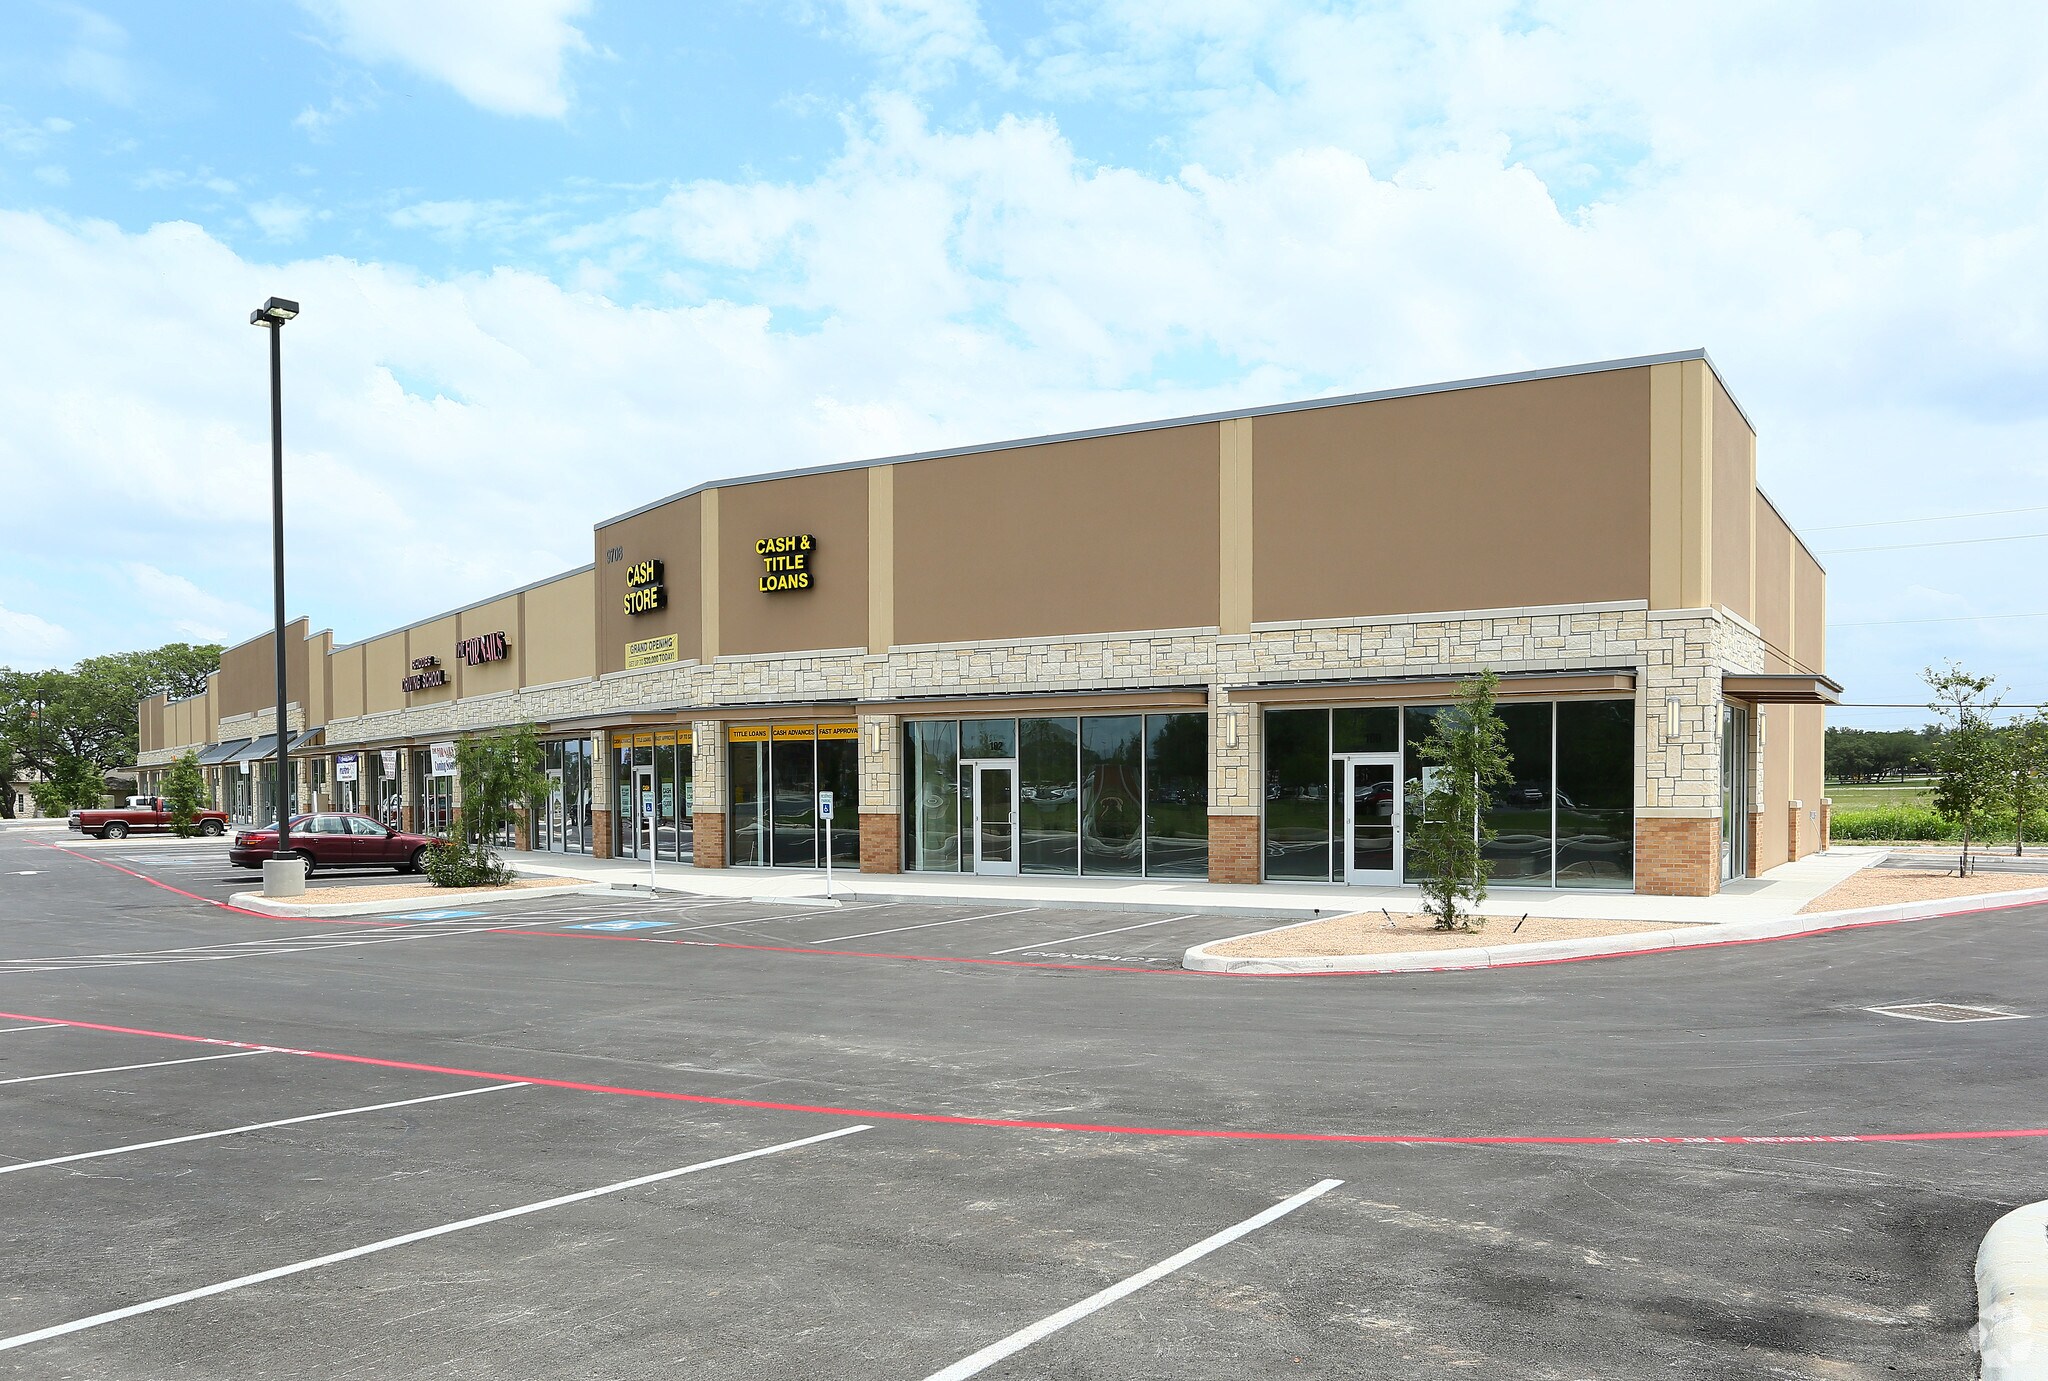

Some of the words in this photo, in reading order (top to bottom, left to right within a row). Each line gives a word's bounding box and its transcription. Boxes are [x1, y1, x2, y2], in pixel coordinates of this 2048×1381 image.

[755, 537, 796, 555] CASH
[799, 535, 811, 550] &
[626, 560, 654, 587] CASH
[763, 555, 804, 572] TITLE
[759, 572, 809, 592] LOANS
[624, 587, 658, 615] STORE
[465, 637, 480, 666] FOR
[480, 631, 505, 662] NAILS
[630, 642, 647, 654] GRAND
[649, 637, 672, 650] OPENING
[402, 674, 420, 692] DRIVING
[423, 670, 442, 688] SCHOOL
[990, 741, 1003, 751] 102
